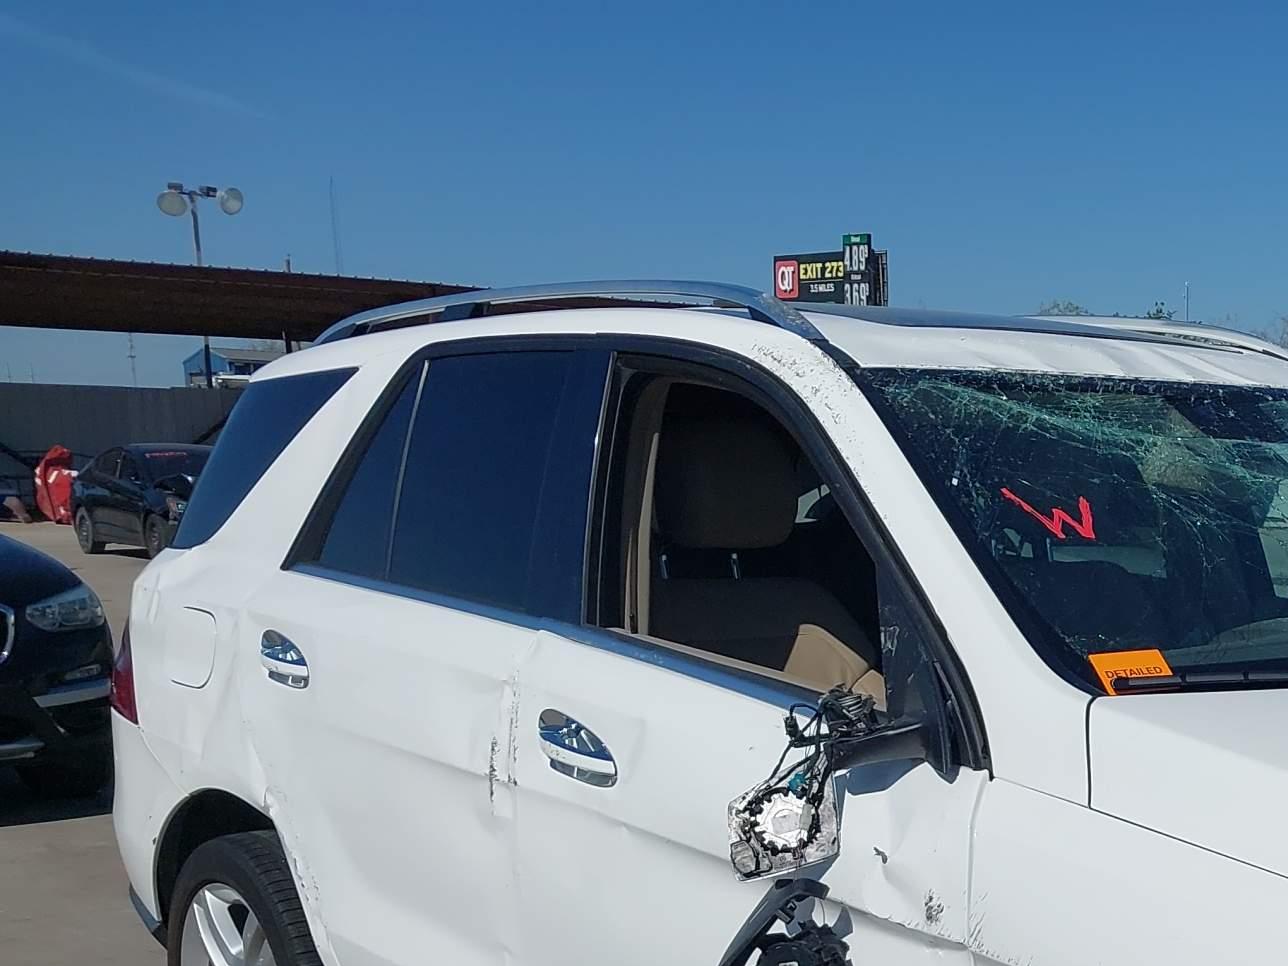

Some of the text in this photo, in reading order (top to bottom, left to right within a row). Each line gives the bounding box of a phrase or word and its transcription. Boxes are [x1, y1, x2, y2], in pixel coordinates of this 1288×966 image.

[778, 266, 794, 292] QT
[799, 260, 844, 280] EXIT 273
[1104, 666, 1163, 679] DETAILED
